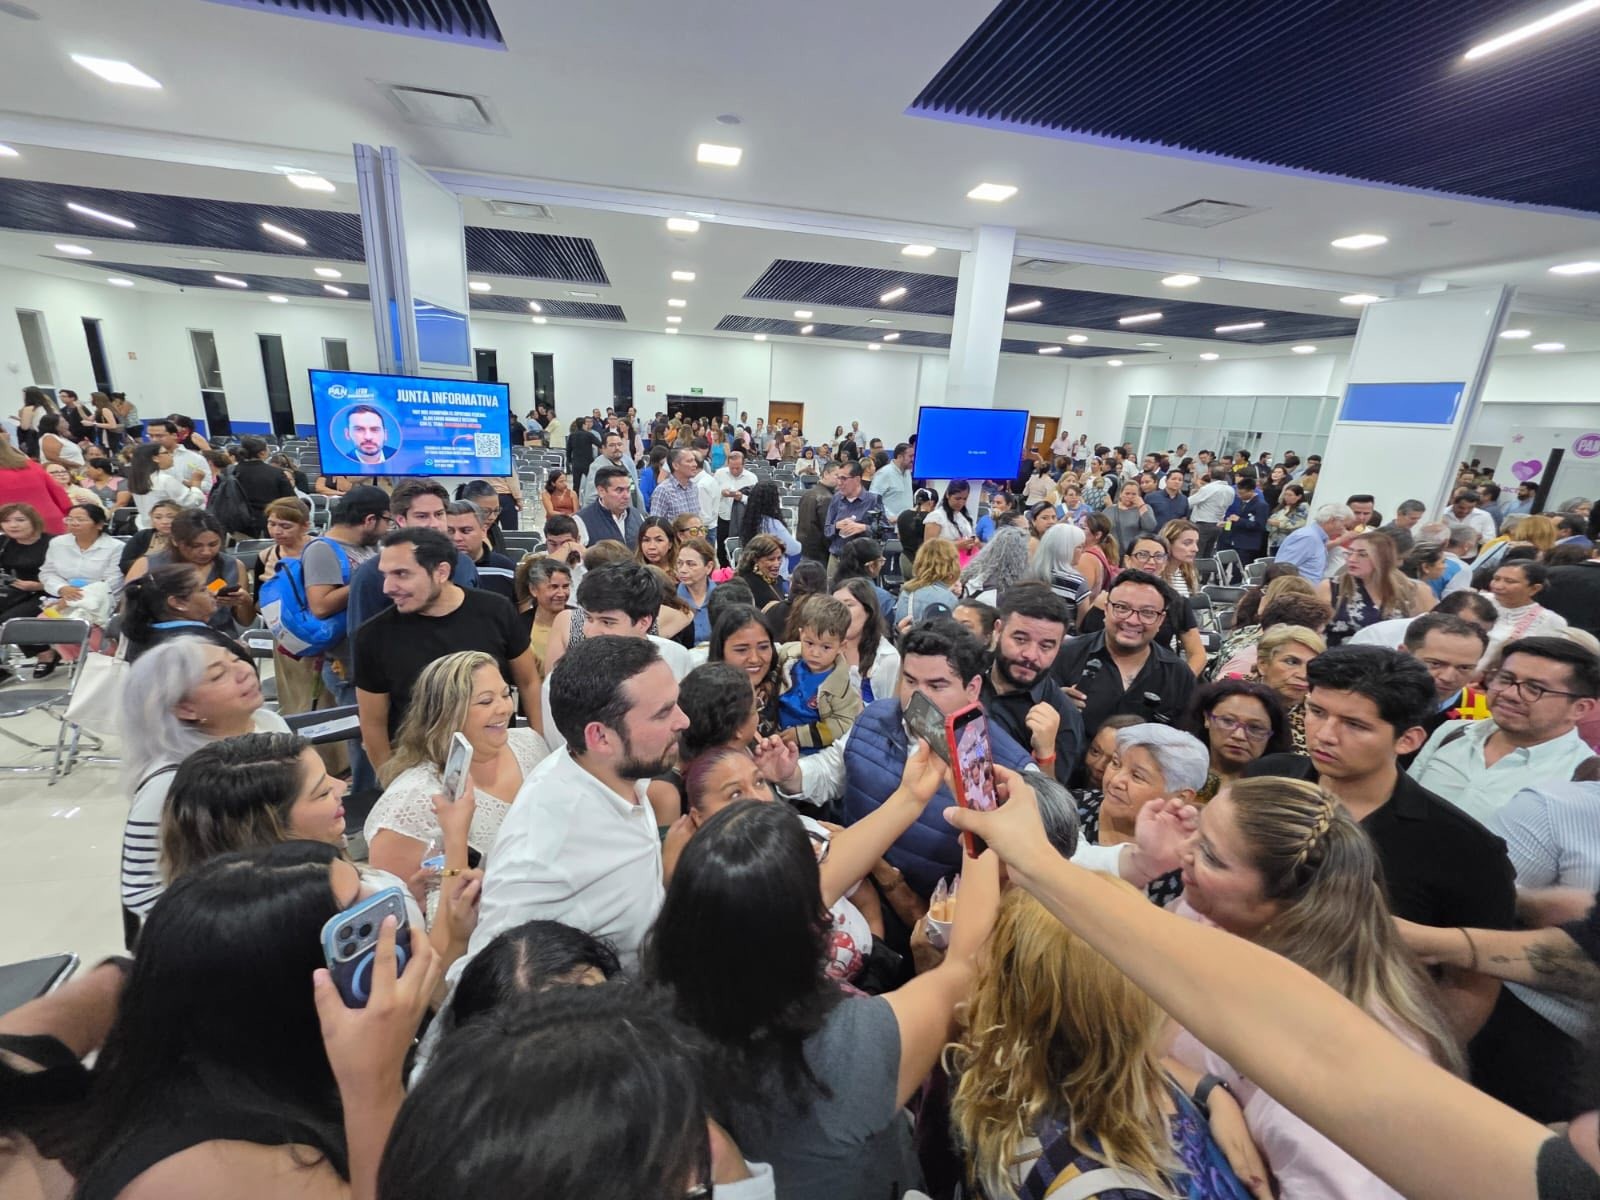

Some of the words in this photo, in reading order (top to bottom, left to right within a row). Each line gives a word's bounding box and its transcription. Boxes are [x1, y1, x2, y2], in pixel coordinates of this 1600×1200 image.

[328, 386, 347, 397] PAN
[396, 389, 430, 404] JUNTA
[431, 391, 499, 408] INFORMATIVA
